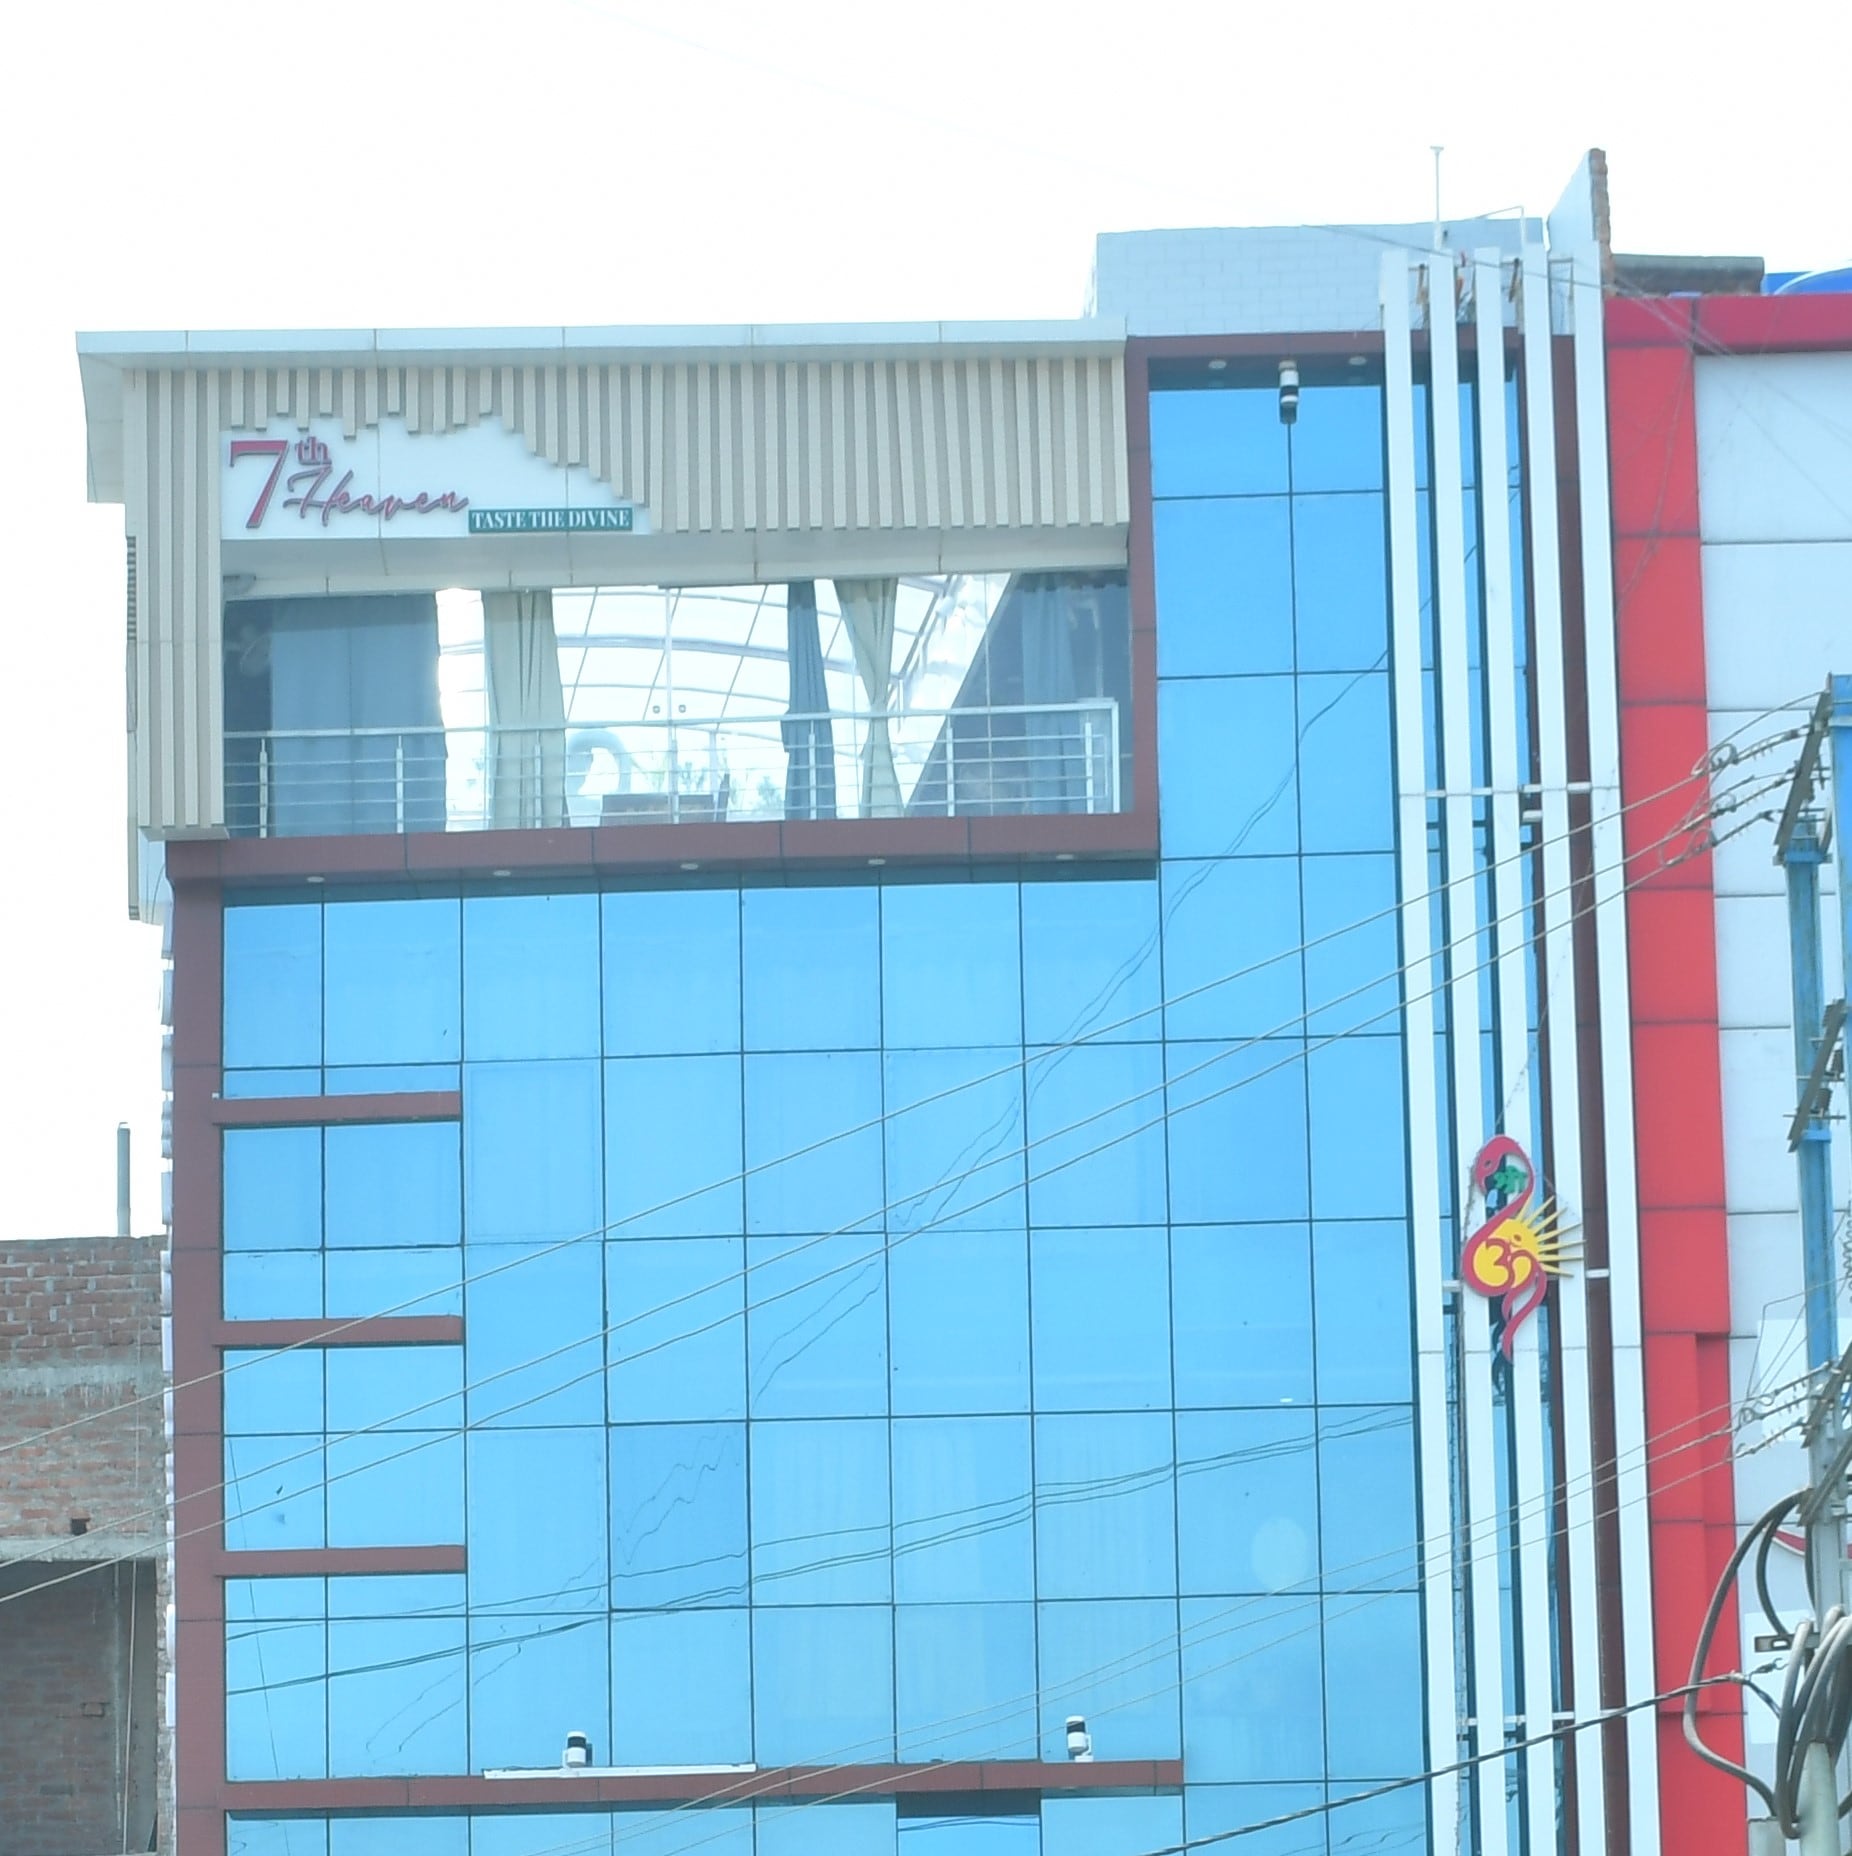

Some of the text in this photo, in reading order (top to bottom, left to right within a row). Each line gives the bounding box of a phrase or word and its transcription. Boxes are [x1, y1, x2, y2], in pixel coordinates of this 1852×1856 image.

[229, 439, 290, 529] 7
[283, 464, 469, 527] Heaven
[472, 509, 630, 531] TASTE THE DIVINE
